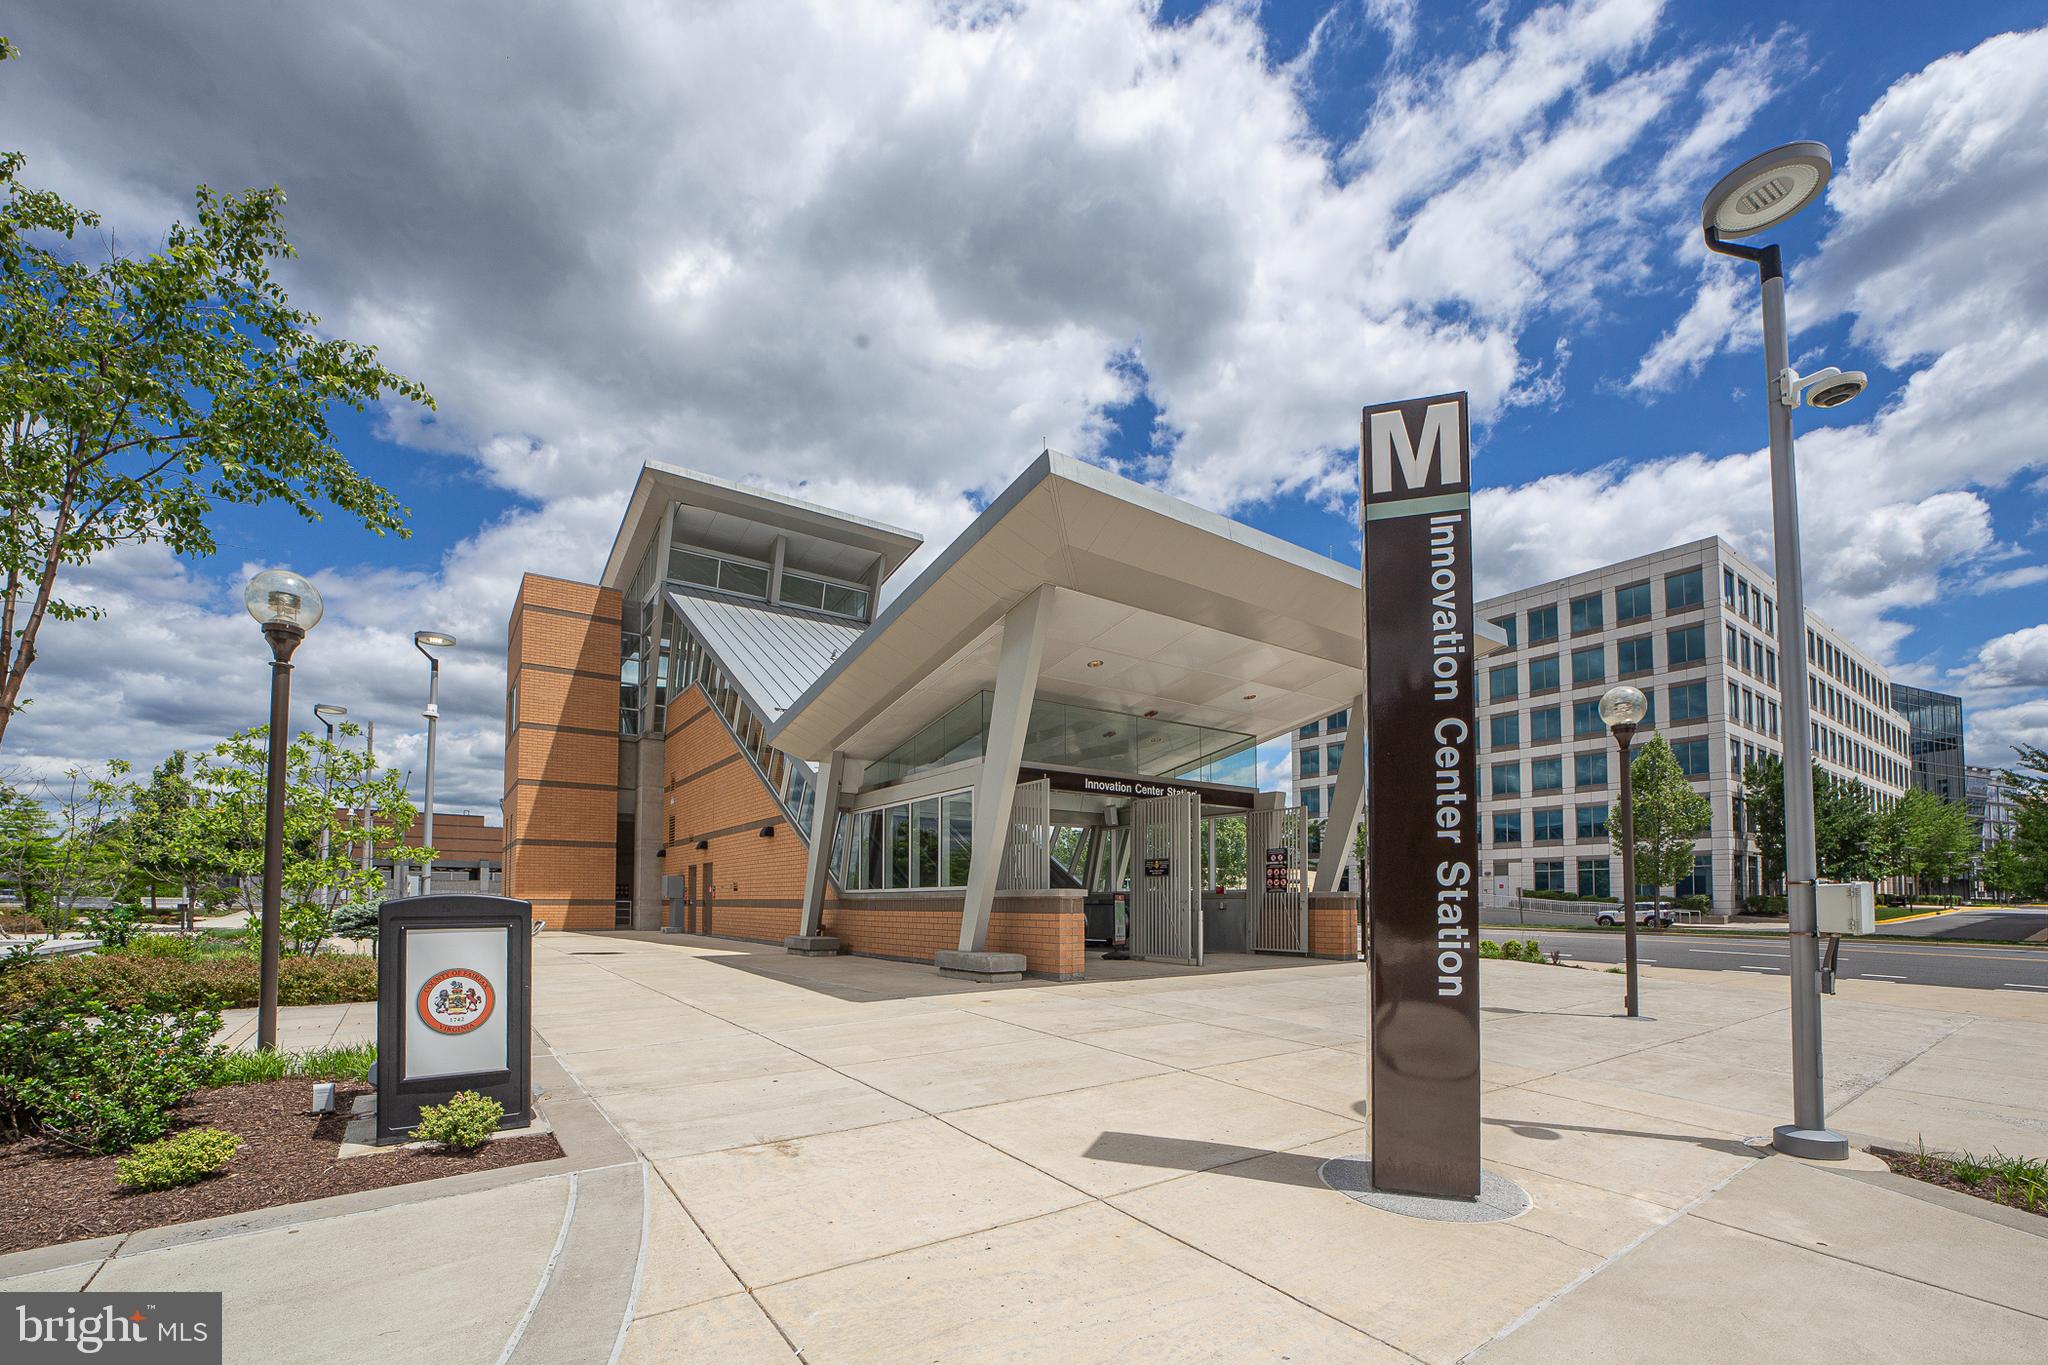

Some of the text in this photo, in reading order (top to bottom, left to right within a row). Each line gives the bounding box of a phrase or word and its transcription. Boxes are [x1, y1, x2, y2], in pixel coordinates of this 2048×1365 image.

[1371, 401, 1461, 494] M
[1430, 514, 1471, 996] Innovation Center Station
[1085, 778, 1197, 797] Innovation Center Stat
[424, 973, 449, 993] COUNTY
[463, 971, 488, 989] FAIRFAX
[439, 1023, 475, 1032] VIRGINIA
